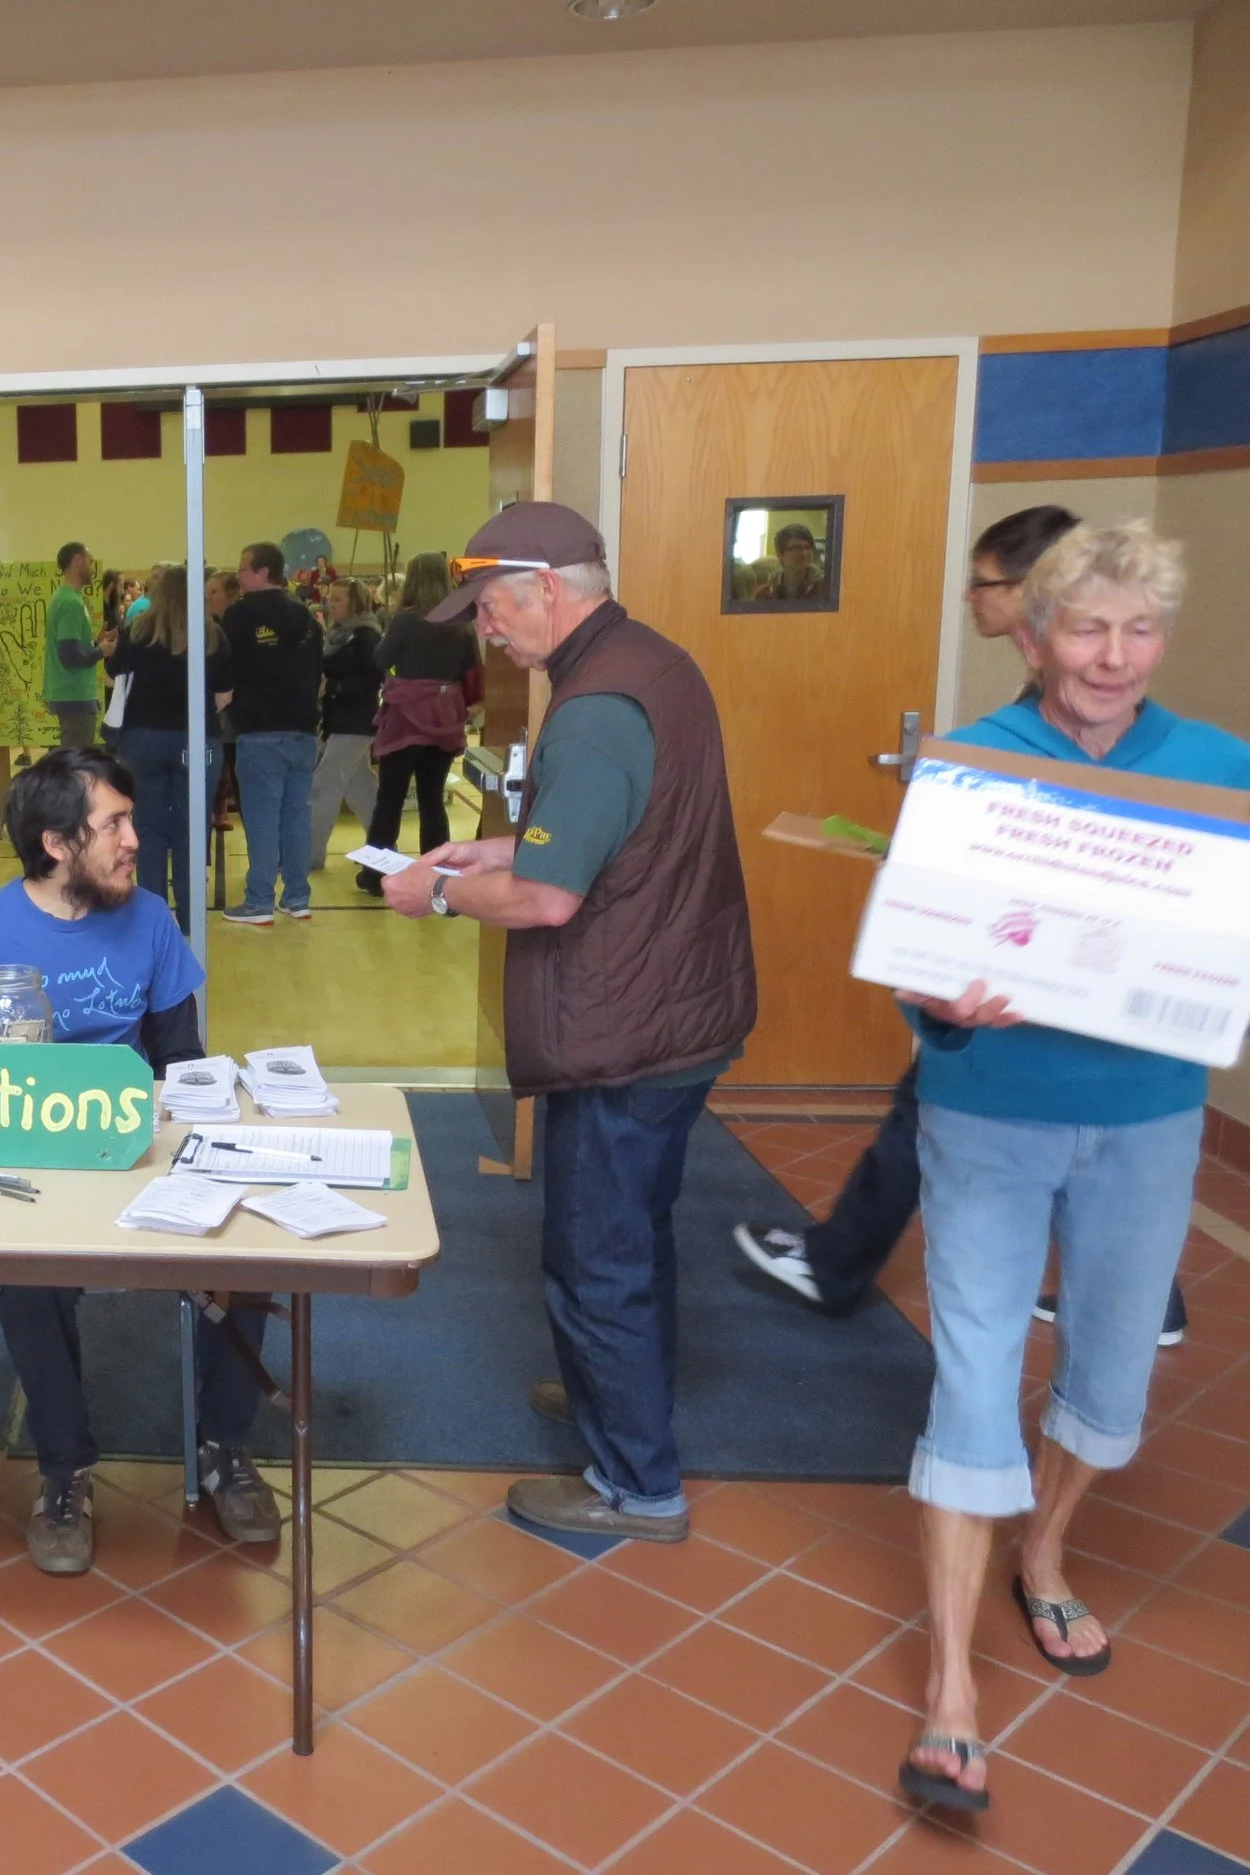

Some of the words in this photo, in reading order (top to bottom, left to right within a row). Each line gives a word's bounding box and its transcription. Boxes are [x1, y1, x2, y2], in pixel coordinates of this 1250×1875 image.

[17, 582, 42, 596] We
[50, 578, 103, 597] Nd?
[987, 801, 1062, 828] FRESH
[1069, 818, 1194, 857] SQUEEZED
[996, 824, 1072, 851] FRESH
[1078, 841, 1174, 873] FROZEN
